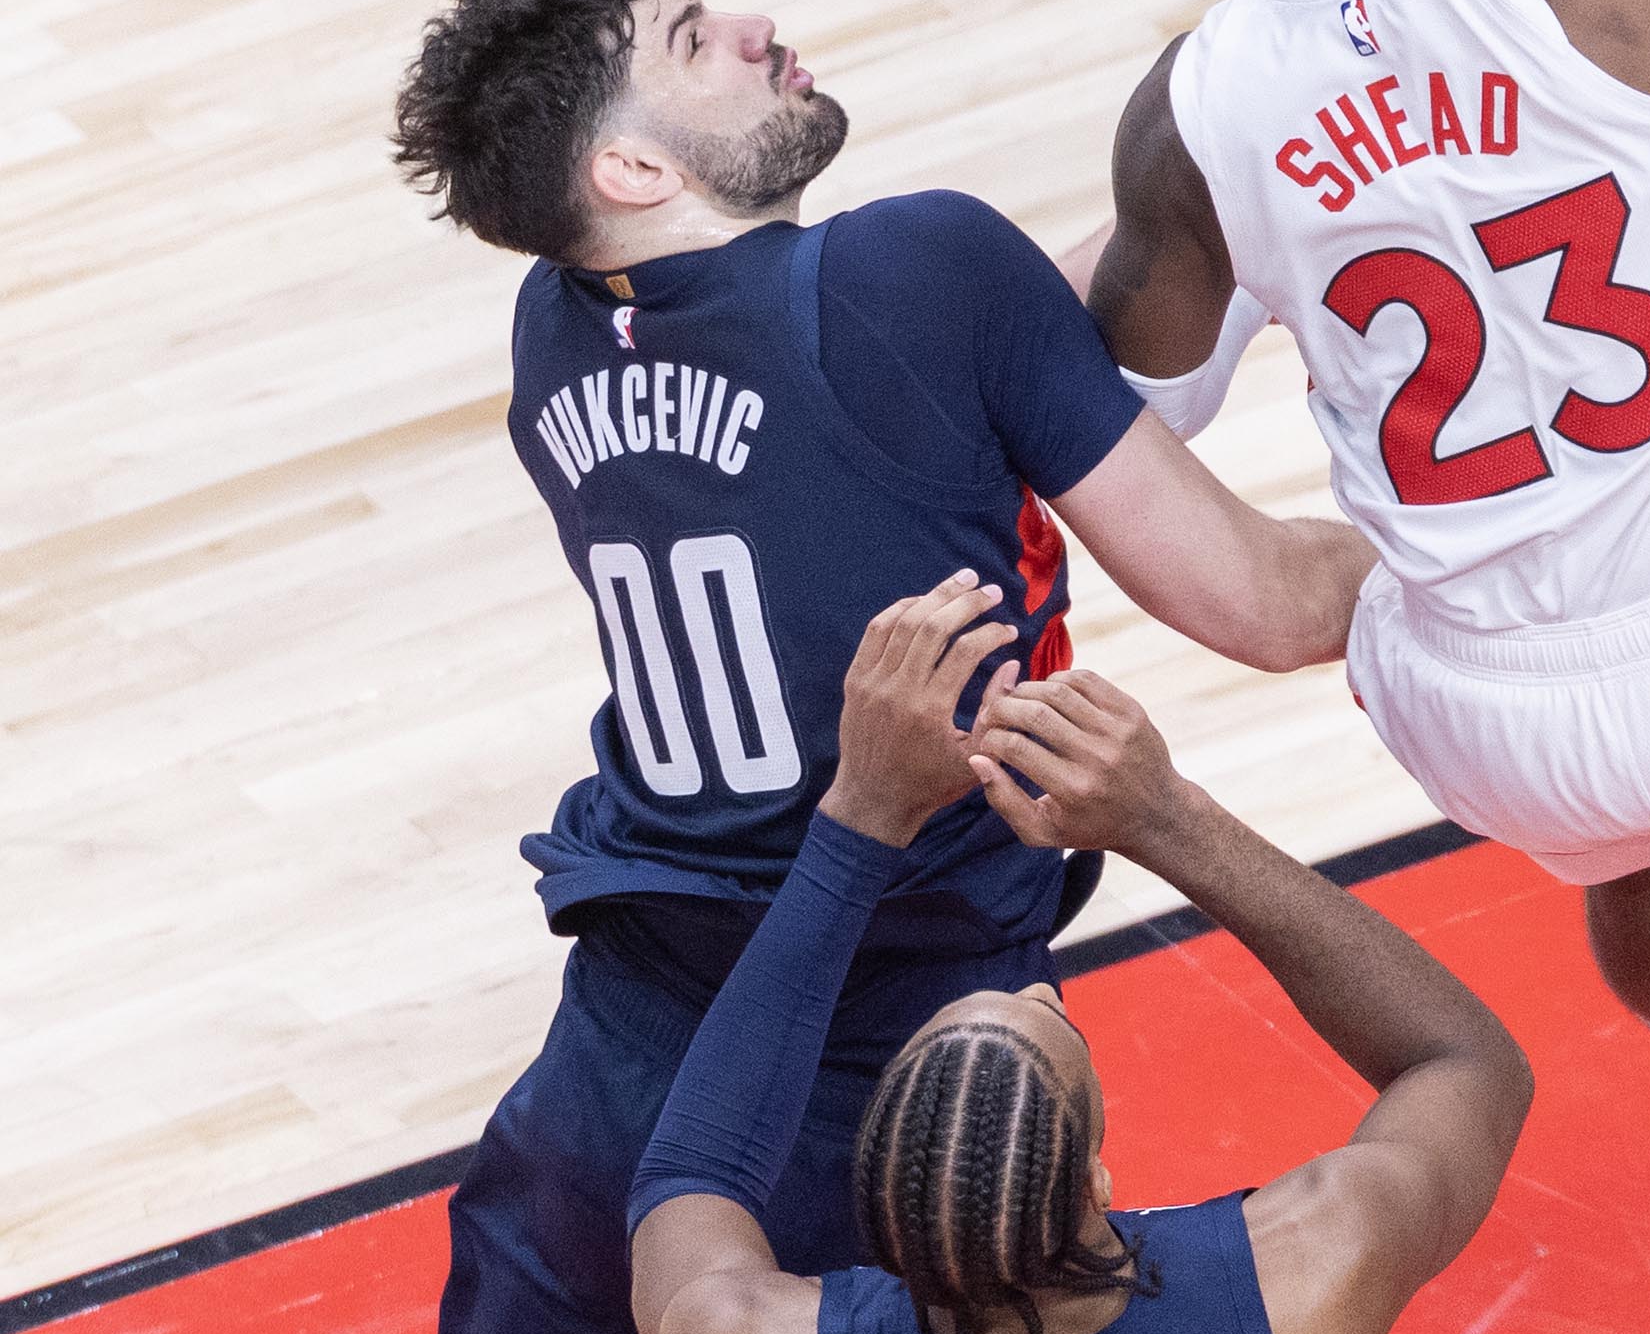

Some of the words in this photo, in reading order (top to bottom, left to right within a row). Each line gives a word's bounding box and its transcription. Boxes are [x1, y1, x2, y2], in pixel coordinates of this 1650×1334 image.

[1275, 71, 1520, 213] SHEAD
[536, 362, 764, 490] VUKCEVIC
[588, 533, 801, 796] 00
